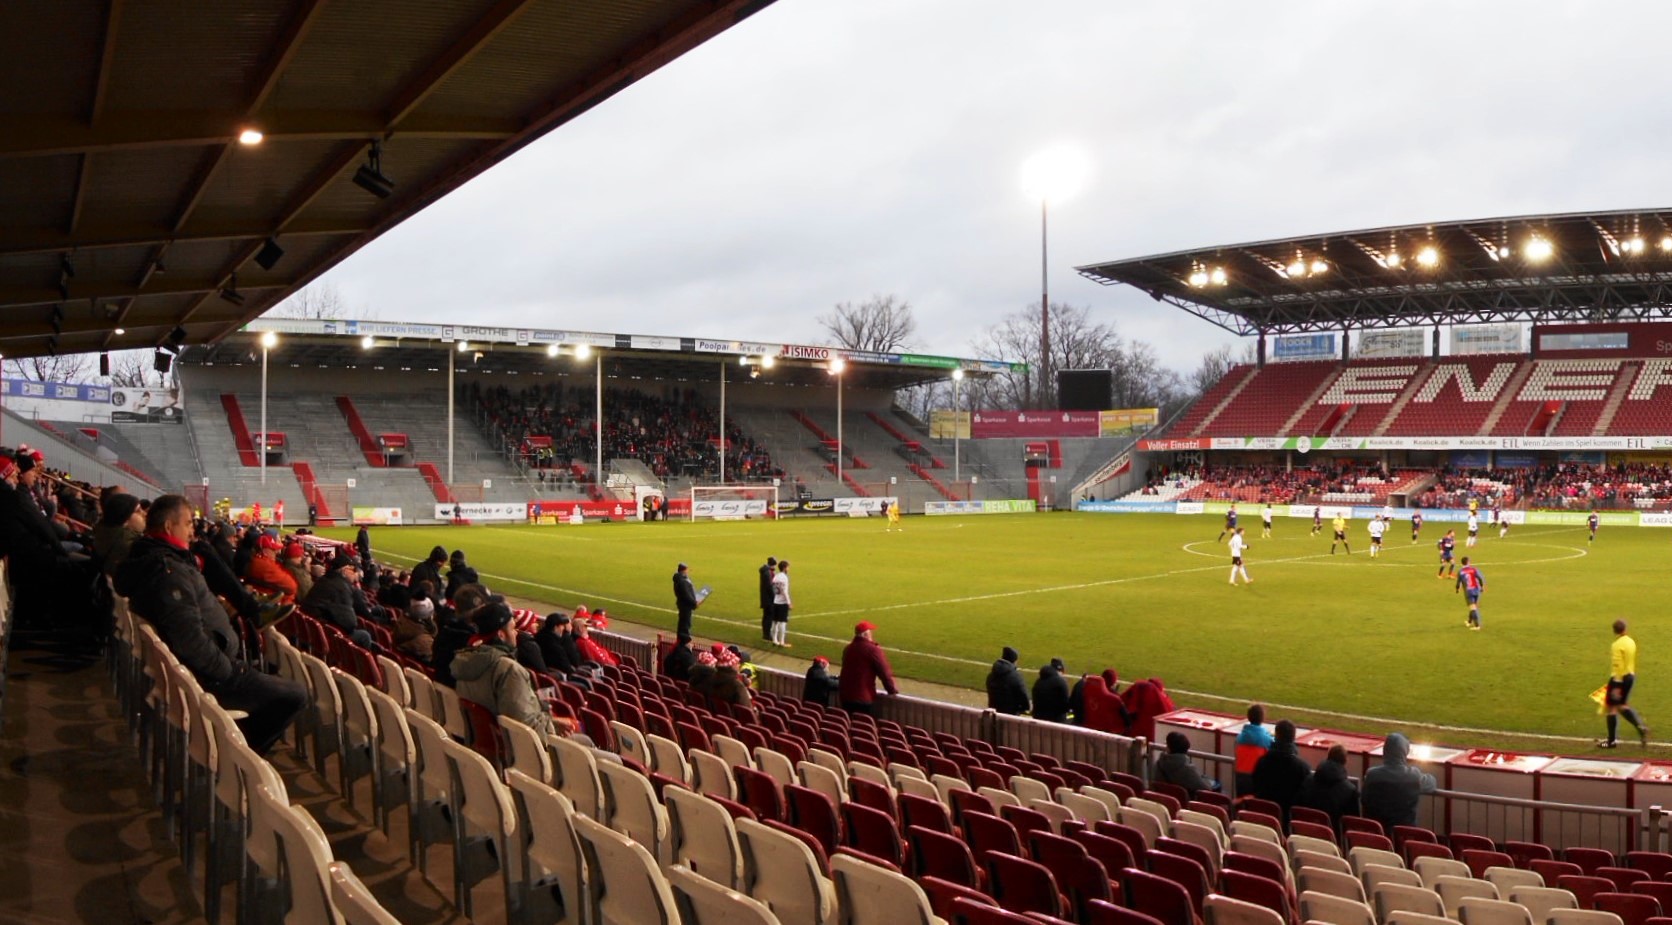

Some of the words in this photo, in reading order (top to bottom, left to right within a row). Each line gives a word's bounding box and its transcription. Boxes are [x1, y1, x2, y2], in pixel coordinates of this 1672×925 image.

[1502, 438, 1520, 448] ETL
[1576, 440, 1592, 448] Spiel
[1628, 438, 1646, 448] ETL
